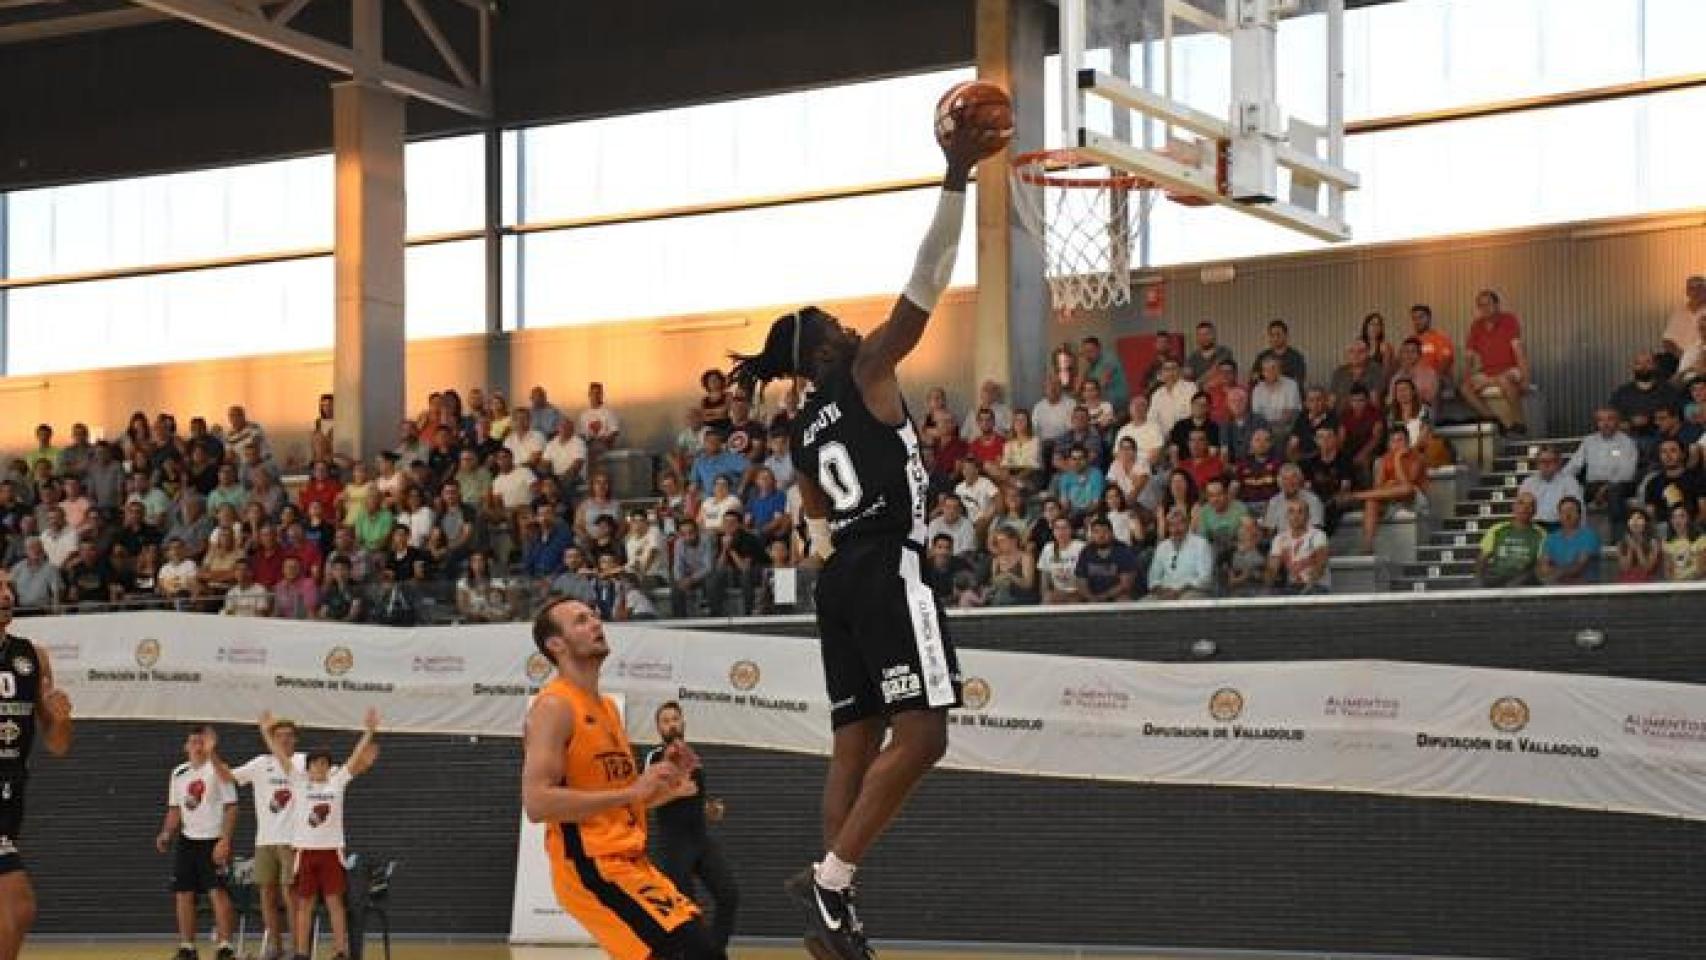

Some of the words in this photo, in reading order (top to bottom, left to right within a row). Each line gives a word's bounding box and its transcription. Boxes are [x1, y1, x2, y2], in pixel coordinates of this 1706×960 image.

[819, 441, 863, 510] 0
[980, 715, 1044, 731] VALLADOLID
[1213, 728, 1229, 739] DE
[1233, 725, 1305, 742] VALLADOLID
[1495, 738, 1513, 753] DE
[1519, 737, 1600, 759] VALLADOLID
